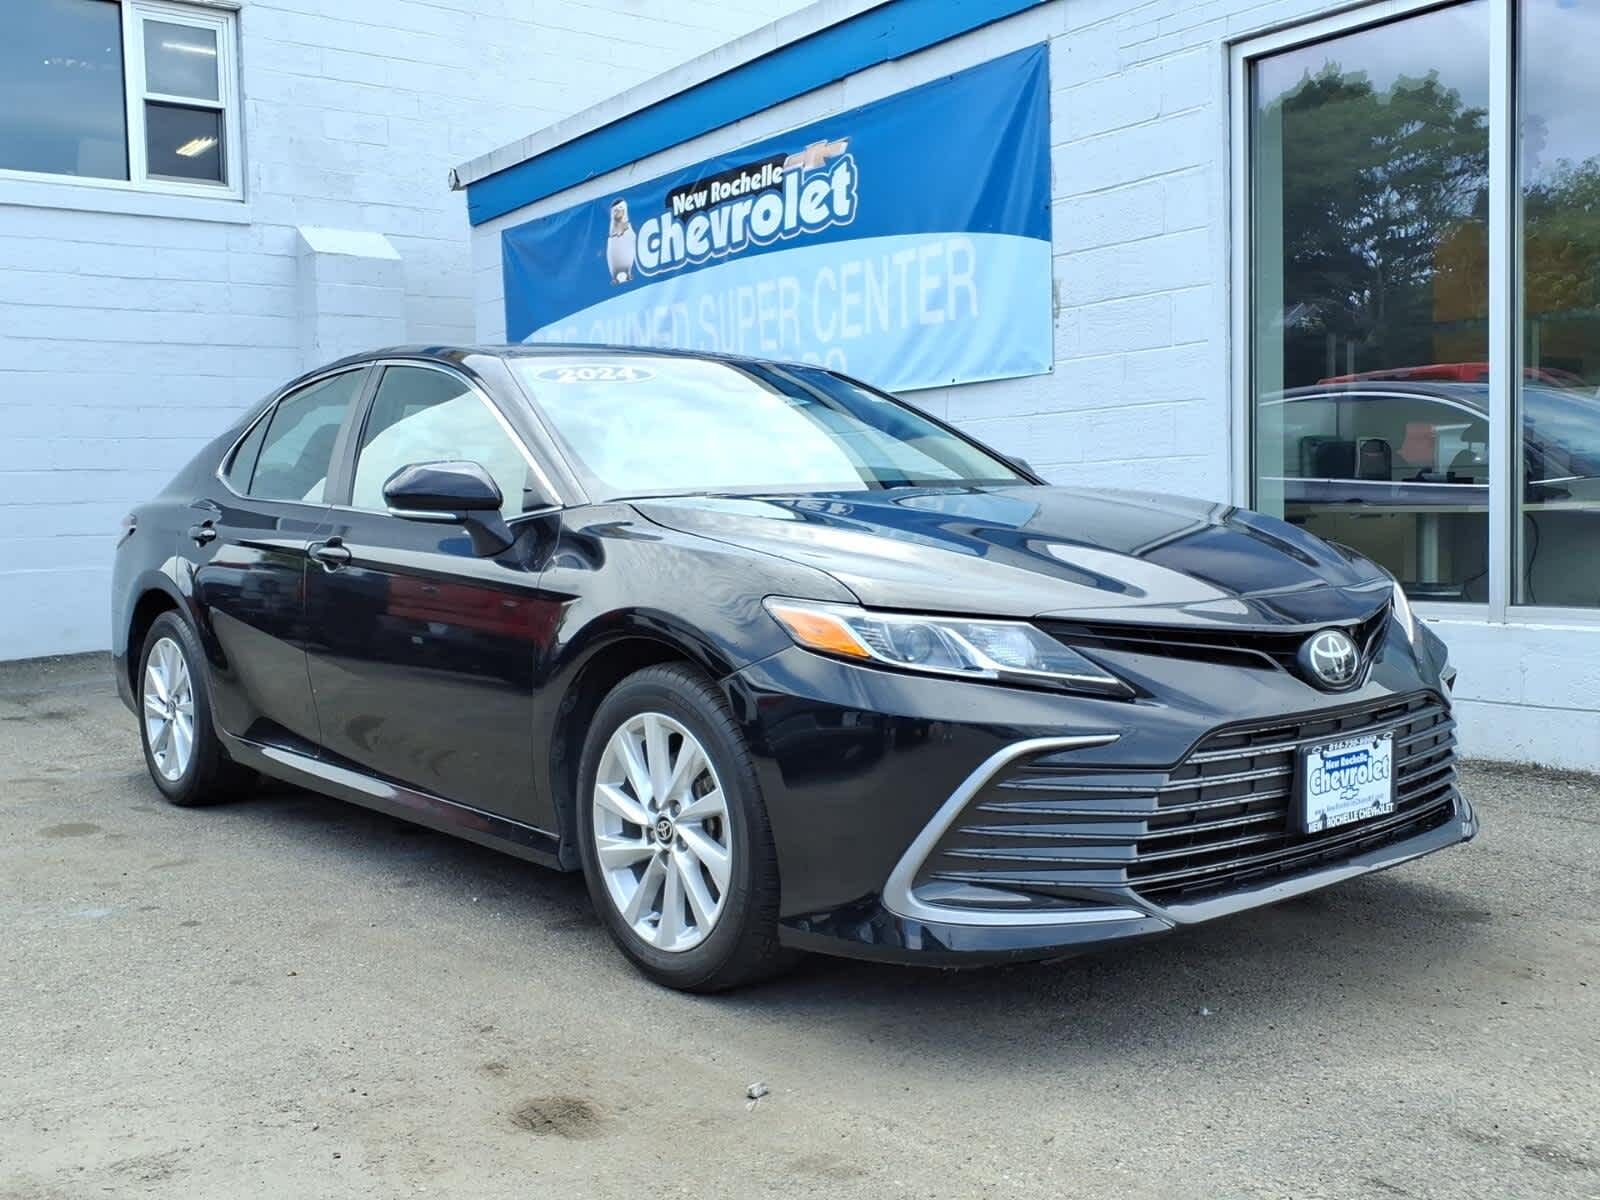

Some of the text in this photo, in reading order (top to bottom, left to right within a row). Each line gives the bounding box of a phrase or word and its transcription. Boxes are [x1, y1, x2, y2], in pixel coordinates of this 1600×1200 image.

[672, 163, 784, 217] New Rochelle
[635, 159, 853, 270] Chevrolet
[697, 276, 801, 351] SUPER
[813, 238, 981, 342] CENTER
[557, 367, 634, 383] 2024
[1310, 754, 1391, 796] Chevrolet
[1327, 809, 1359, 829] ROCHELLE
